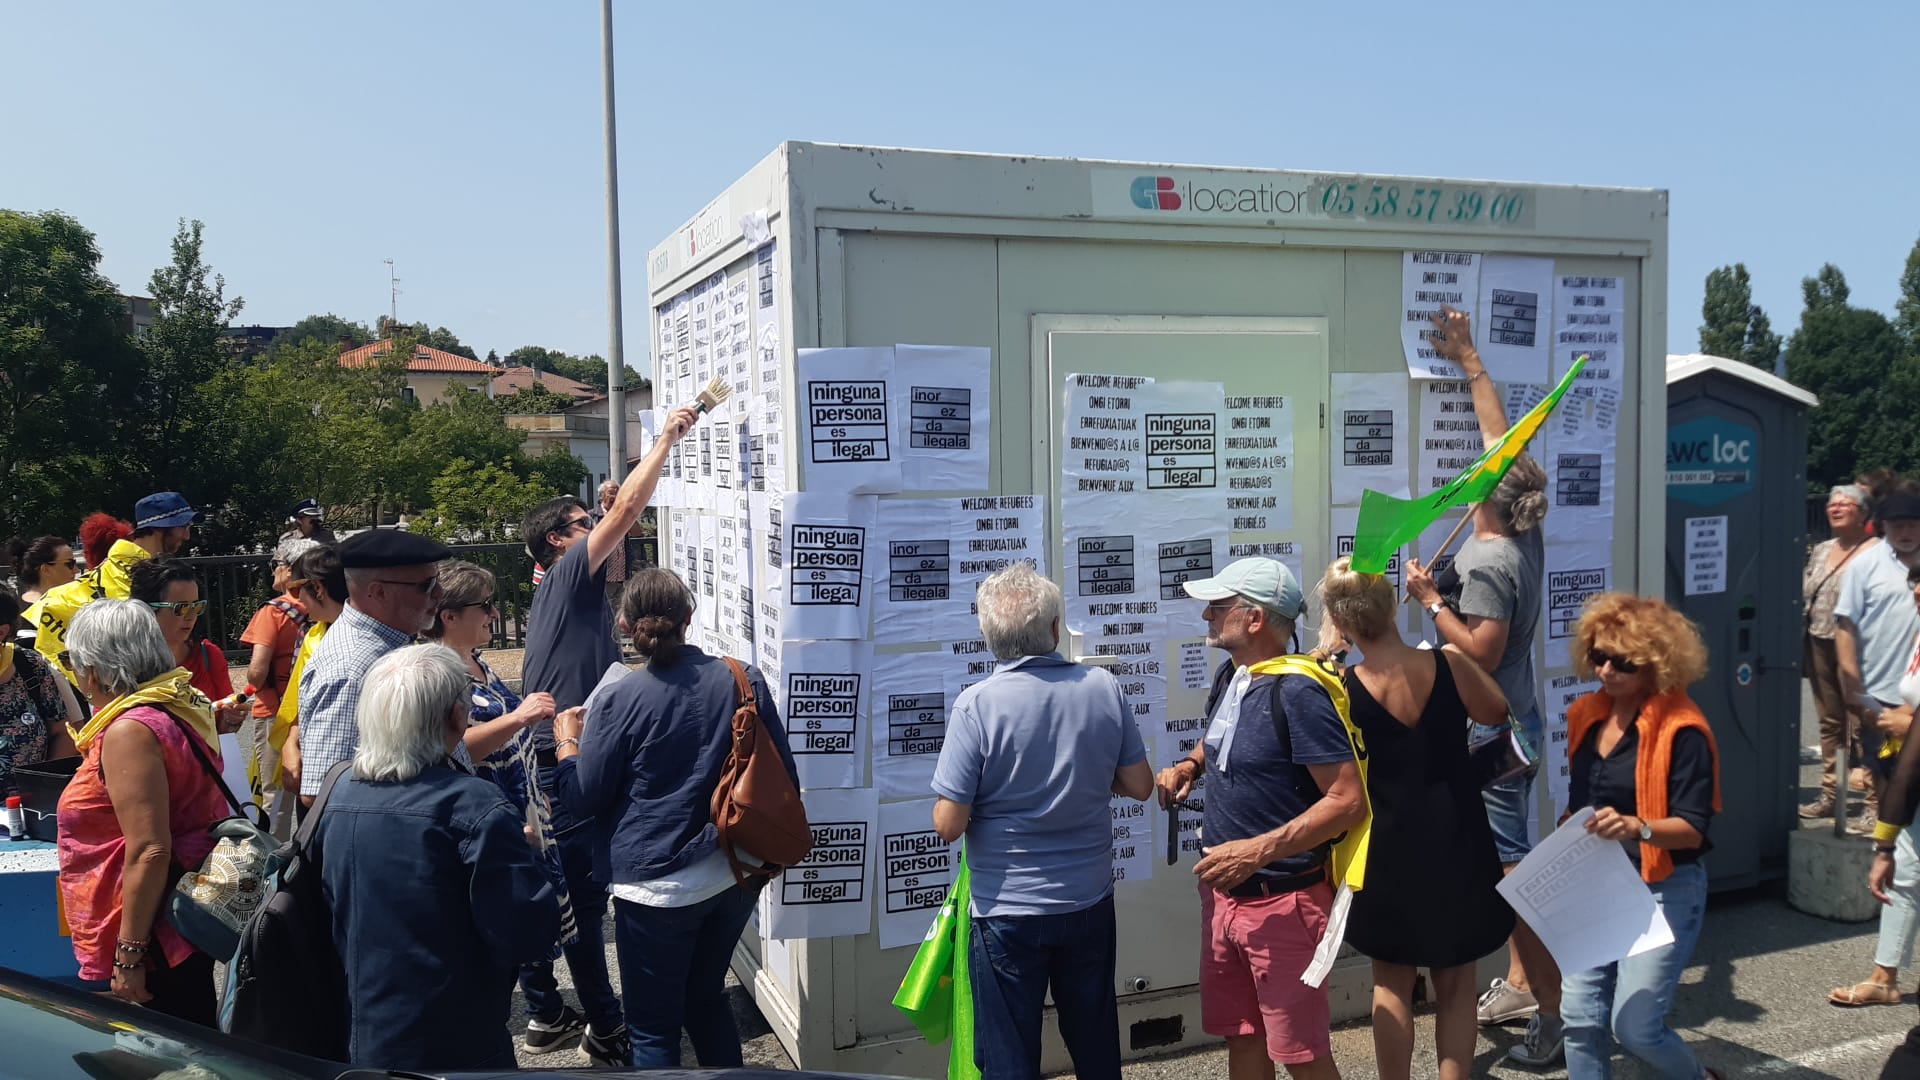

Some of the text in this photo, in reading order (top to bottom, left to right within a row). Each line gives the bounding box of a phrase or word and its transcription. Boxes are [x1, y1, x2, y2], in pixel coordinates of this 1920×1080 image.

[1322, 183, 1523, 223] 05 58 57 39 00
[1496, 292, 1515, 304] inor
[1514, 308, 1526, 317] ez
[1502, 320, 1515, 329] da
[1076, 375, 1111, 389] WELCOME
[1430, 384, 1458, 393] WELCOME
[814, 383, 880, 404] ninguna
[914, 389, 941, 401] inor
[1089, 396, 1130, 410] ONGI ETORRI
[1253, 397, 1283, 409] REFUGEES
[815, 407, 882, 424] persona
[940, 407, 956, 417] ez
[1348, 412, 1369, 424] inor
[926, 420, 943, 432] da
[1080, 416, 1137, 430] ERREFUXIATUAK
[1150, 415, 1211, 435] ninguna
[1232, 417, 1271, 430] ONGI ETORRI
[830, 428, 846, 437] es
[1368, 428, 1381, 436] ez
[924, 434, 967, 449] ilegala
[1071, 436, 1140, 451] BIENVENID@S A L@
[1151, 438, 1211, 454] persona
[1225, 437, 1278, 450] ERREFUXIATUAK
[1356, 440, 1370, 450] da
[1467, 440, 1471, 450] A
[1474, 439, 1484, 450] L@
[832, 440, 875, 459] ilegal
[1713, 434, 1749, 463] loc
[1163, 457, 1177, 466] es
[1226, 456, 1287, 469] NVENID@S A L@S
[1356, 452, 1390, 464] ilegala
[1560, 456, 1580, 466] inor
[1084, 458, 1130, 472] REFUGIAD@S
[1164, 468, 1202, 487] ilegal
[1230, 476, 1272, 489] REFUGIAD@S
[1078, 479, 1134, 492] BIENVENUE AUX
[961, 496, 1034, 510] WELCOME REFUGEES
[1262, 496, 1277, 509] AUX
[977, 518, 1019, 531] ONGI ETORRI
[893, 544, 919, 555] inor
[969, 538, 1027, 552] ERREFUXIATUAK
[1082, 539, 1106, 551] inor
[1162, 545, 1186, 556] inor
[1230, 542, 1293, 557] WELCOME REFUGEES
[920, 560, 935, 568] ez
[1106, 556, 1121, 564] ez
[1186, 559, 1200, 568] ez
[811, 571, 826, 580] es
[905, 574, 921, 584] da
[1092, 568, 1109, 579] da
[1173, 572, 1189, 583] da
[1552, 572, 1601, 590] ninguna
[812, 584, 854, 603] ilega
[903, 587, 946, 600] ilegala
[1091, 582, 1132, 594] ilegala
[1089, 602, 1157, 616] WELCOME REFUGEES
[1104, 622, 1144, 636] ONGI ETORRI
[1096, 642, 1151, 656] ERREFUXIATUAK
[968, 662, 985, 675] ONGI
[1136, 664, 1141, 674] A
[1143, 662, 1159, 674] L@S
[794, 675, 854, 696] ningun
[794, 700, 853, 716] person
[892, 697, 919, 709] inor
[1135, 704, 1150, 715] AUX
[919, 712, 934, 722] ez
[806, 720, 821, 729] es
[1166, 719, 1198, 733] WELCOME
[904, 727, 921, 738] da
[806, 733, 850, 751] ilegal
[1120, 804, 1144, 819] A L@S
[802, 849, 860, 863] ersona
[1120, 846, 1135, 859] AUX
[891, 854, 950, 876] person
[803, 870, 819, 879] es
[904, 878, 919, 887] es
[803, 882, 846, 901] ilegal
[906, 887, 947, 906] ilegal
